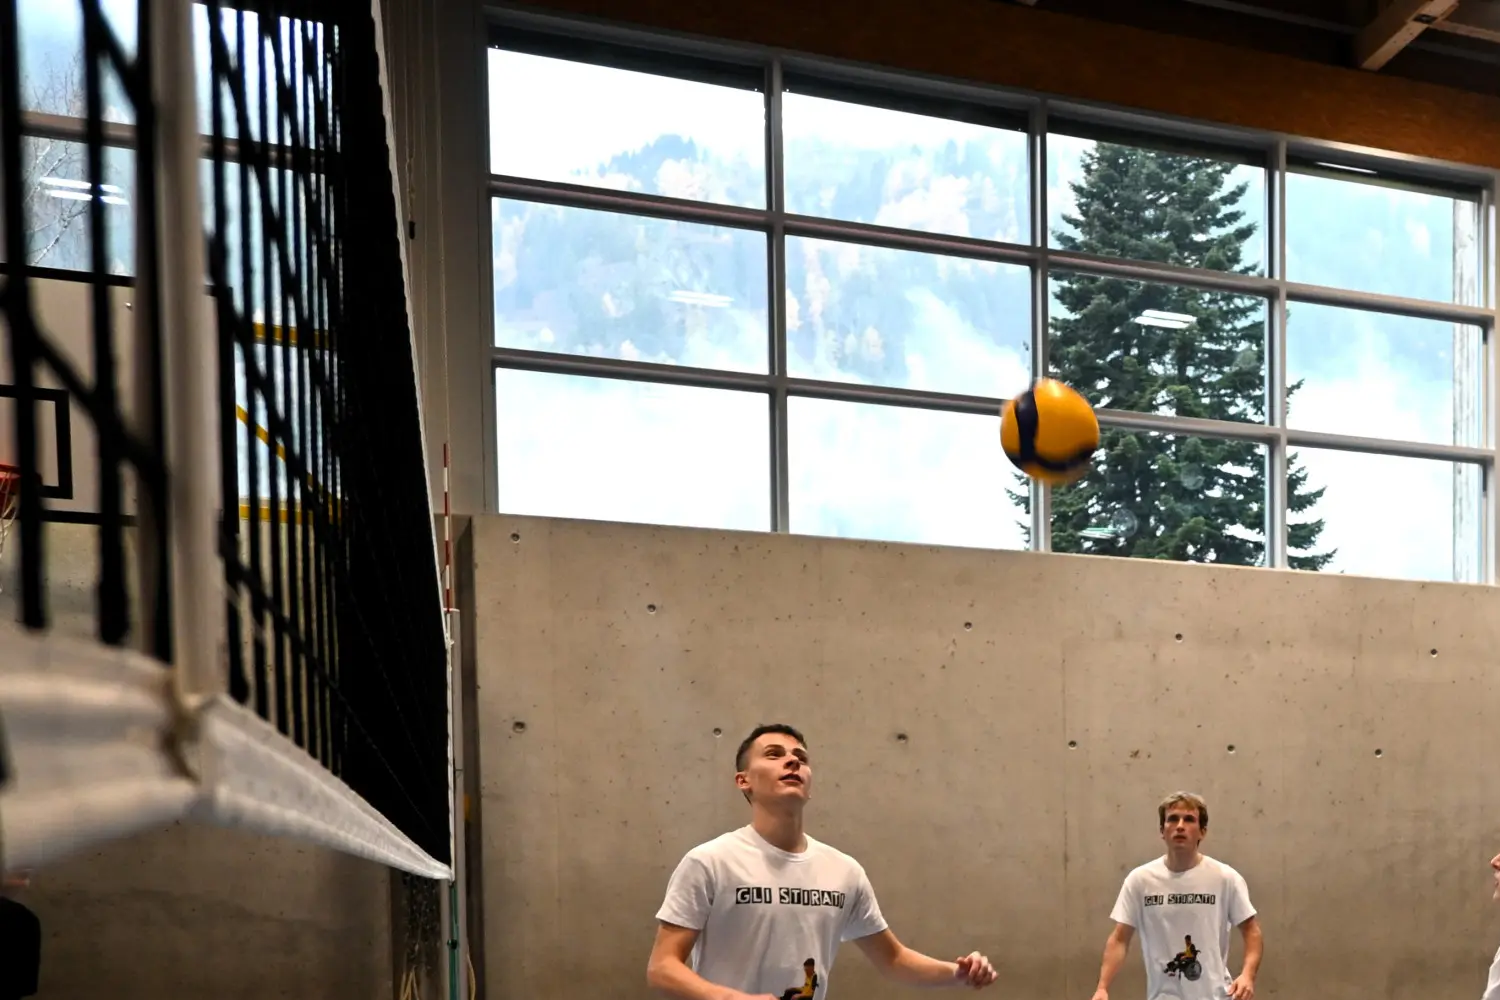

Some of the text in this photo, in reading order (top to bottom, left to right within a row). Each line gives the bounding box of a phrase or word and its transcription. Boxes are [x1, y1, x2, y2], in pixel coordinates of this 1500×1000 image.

[736, 887, 845, 909] GLI STIRATI
[1167, 893, 1216, 905] STIRATI
